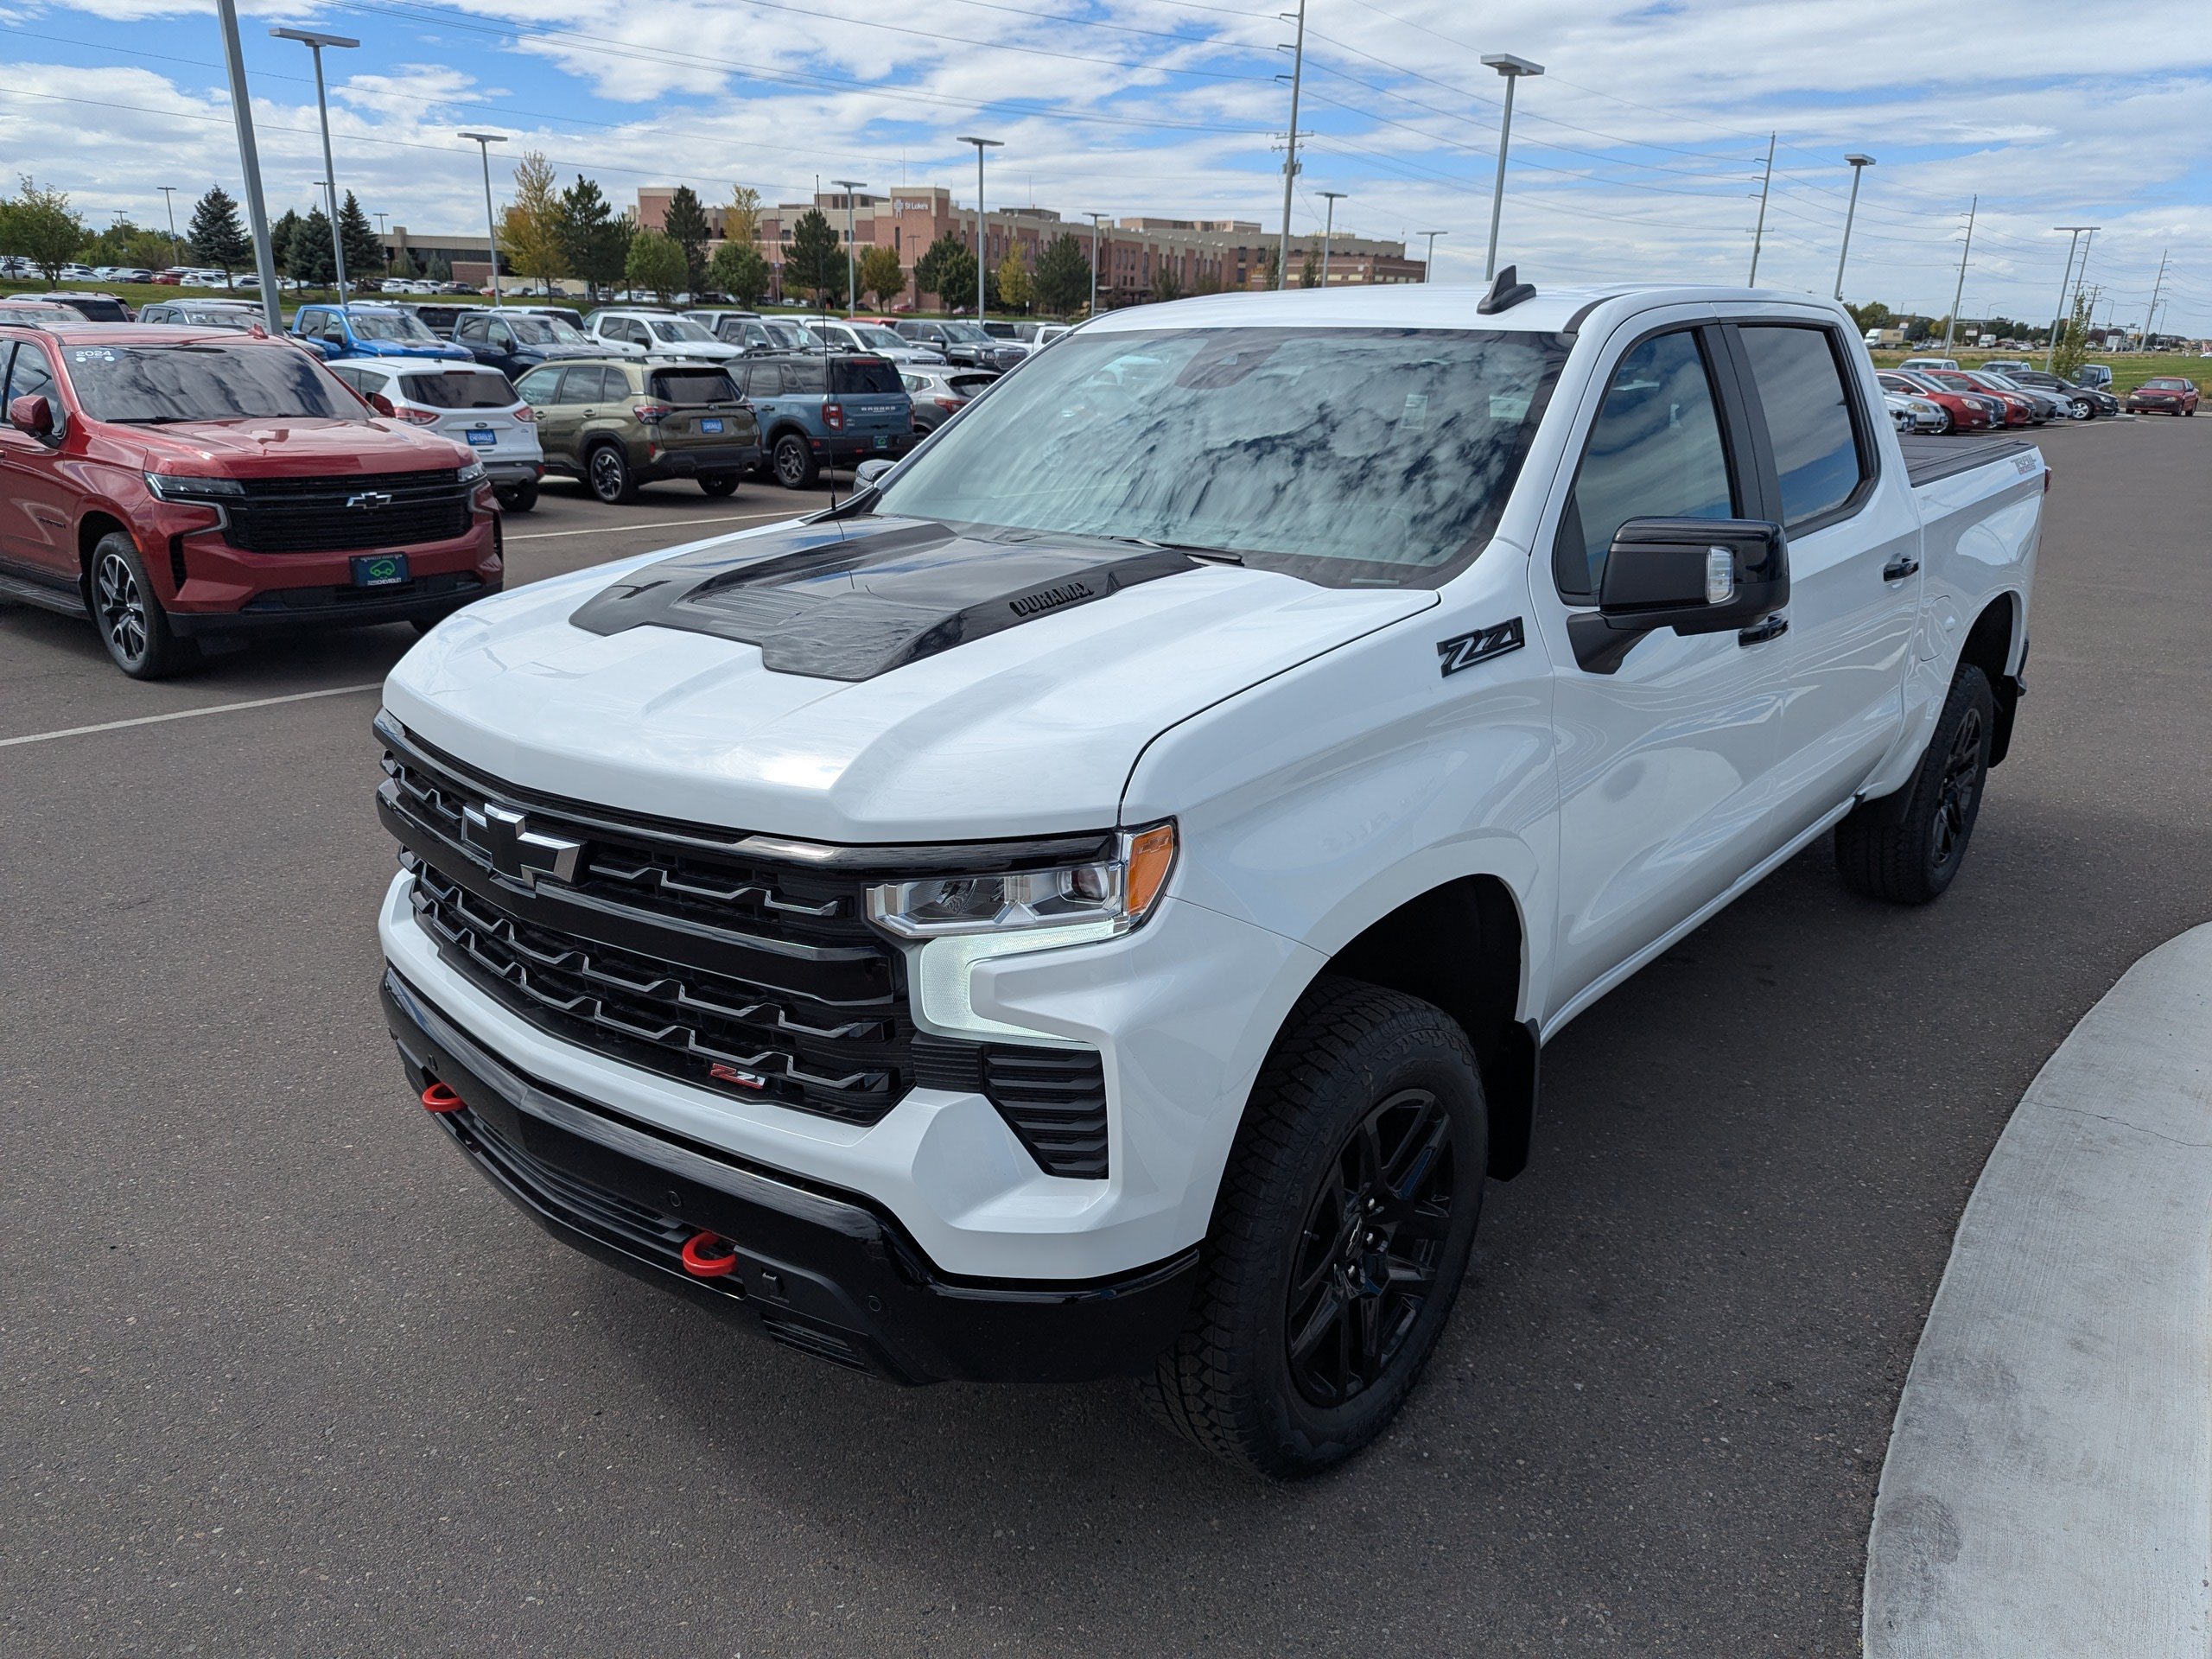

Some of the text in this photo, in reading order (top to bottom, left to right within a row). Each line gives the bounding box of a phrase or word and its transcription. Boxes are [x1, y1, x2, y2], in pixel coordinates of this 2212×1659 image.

[2010, 454, 2037, 467] TRAIL
[1009, 581, 1095, 617] DURAMAX
[1436, 616, 1526, 678] Z71
[710, 1063, 766, 1090] Z71
